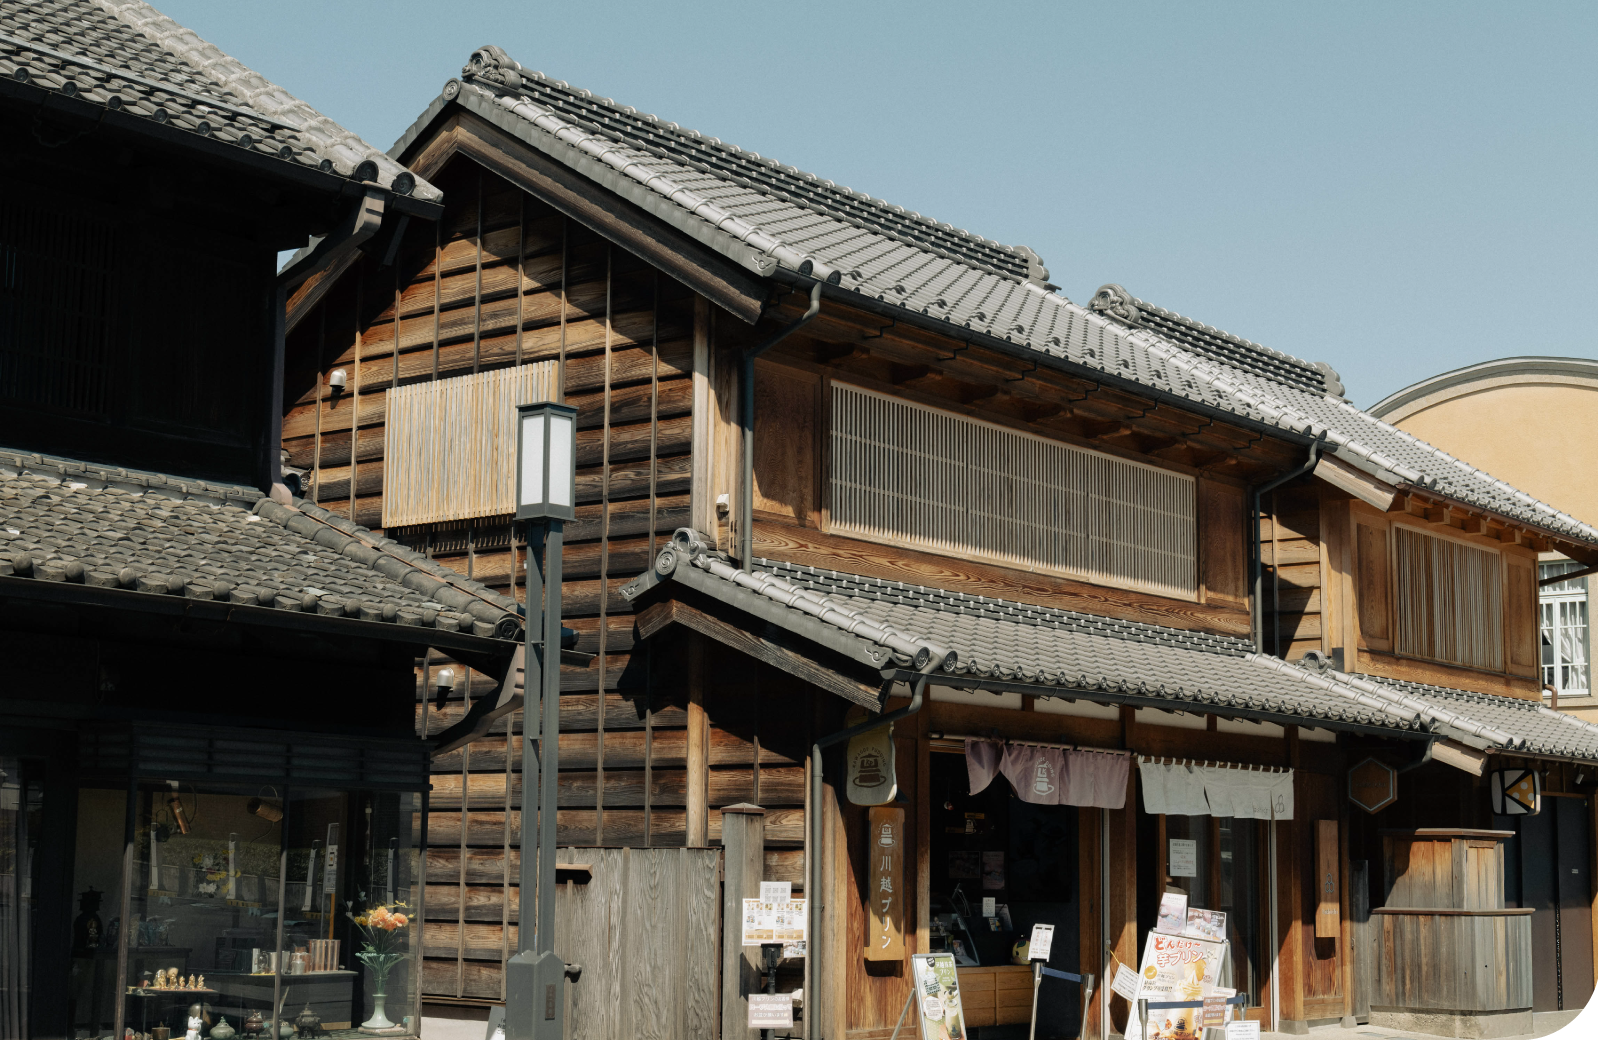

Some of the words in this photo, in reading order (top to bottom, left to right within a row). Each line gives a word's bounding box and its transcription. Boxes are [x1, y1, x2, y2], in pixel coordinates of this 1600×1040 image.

[880, 855, 893, 949] 川越プリン
